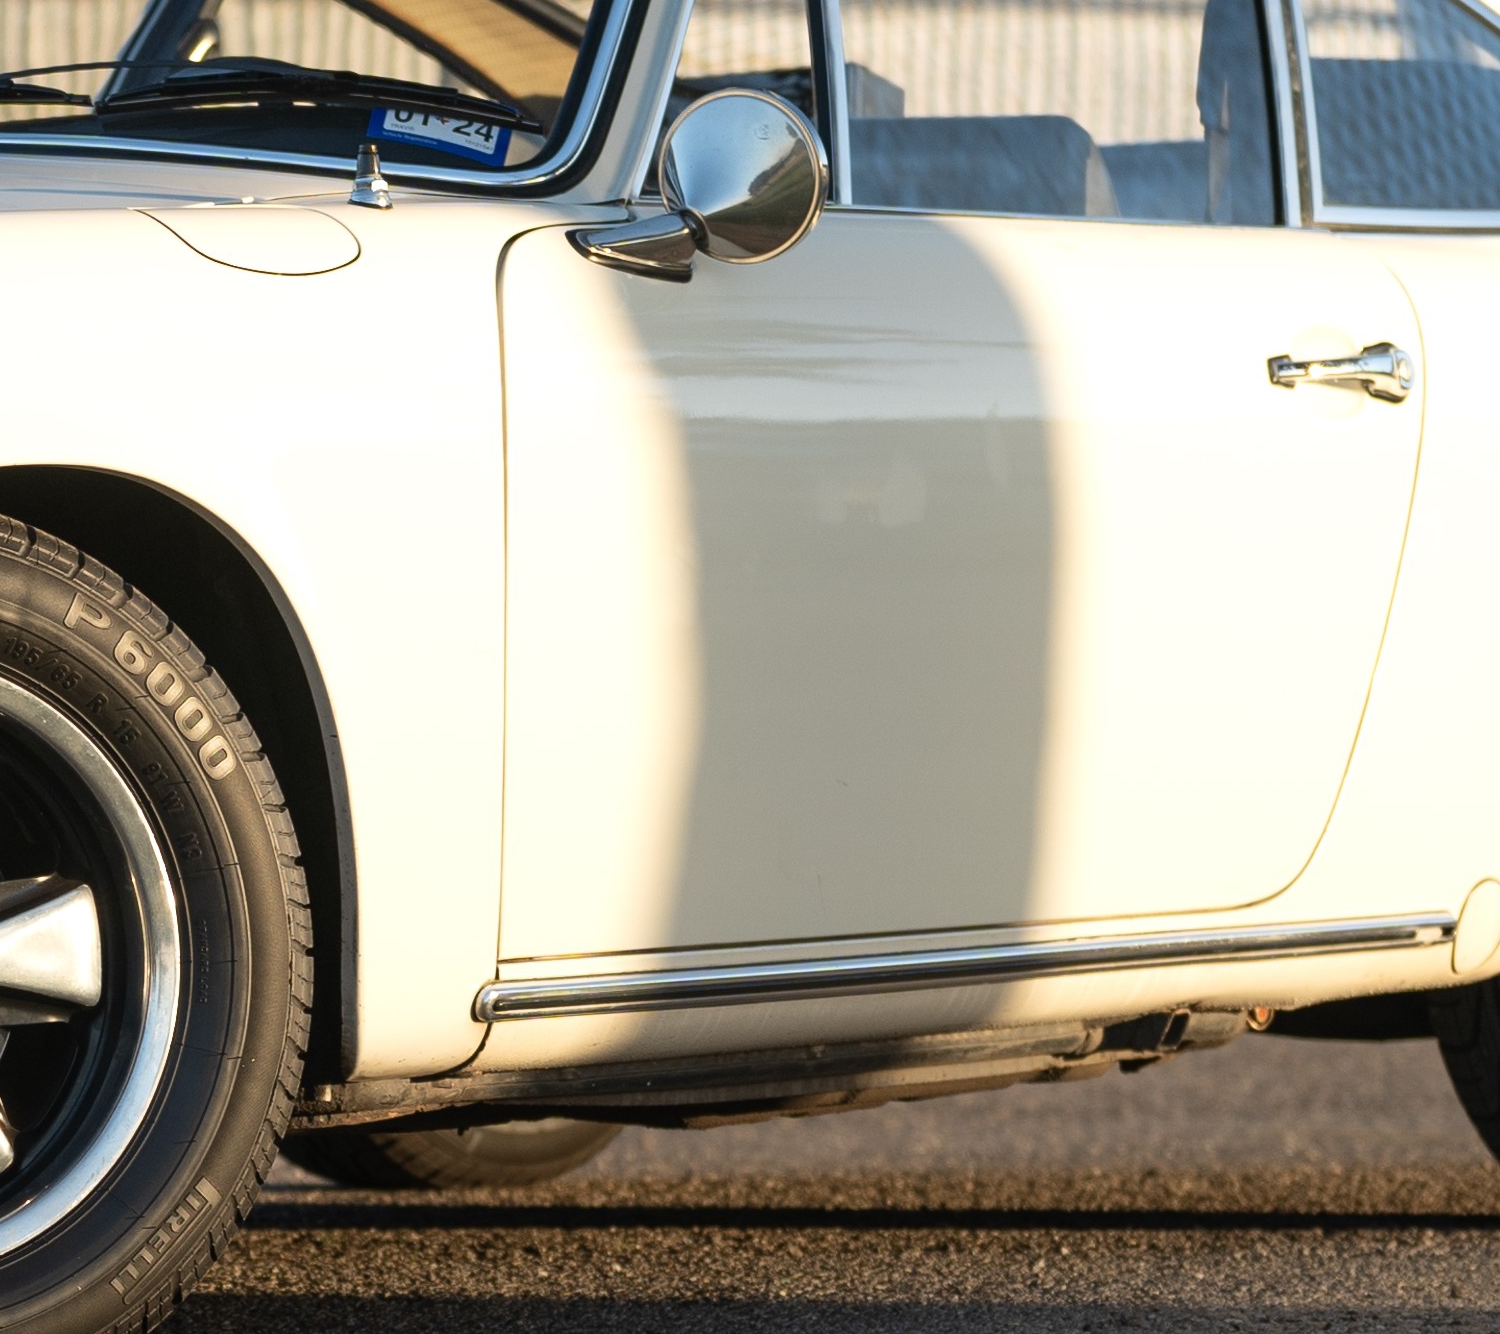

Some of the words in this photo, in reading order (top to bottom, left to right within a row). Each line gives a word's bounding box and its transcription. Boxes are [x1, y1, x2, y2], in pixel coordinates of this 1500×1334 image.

[3, 636, 84, 691] 195/65
[63, 591, 112, 629] P
[114, 629, 237, 782] 6000
[109, 1175, 222, 1304] PIRELLI
